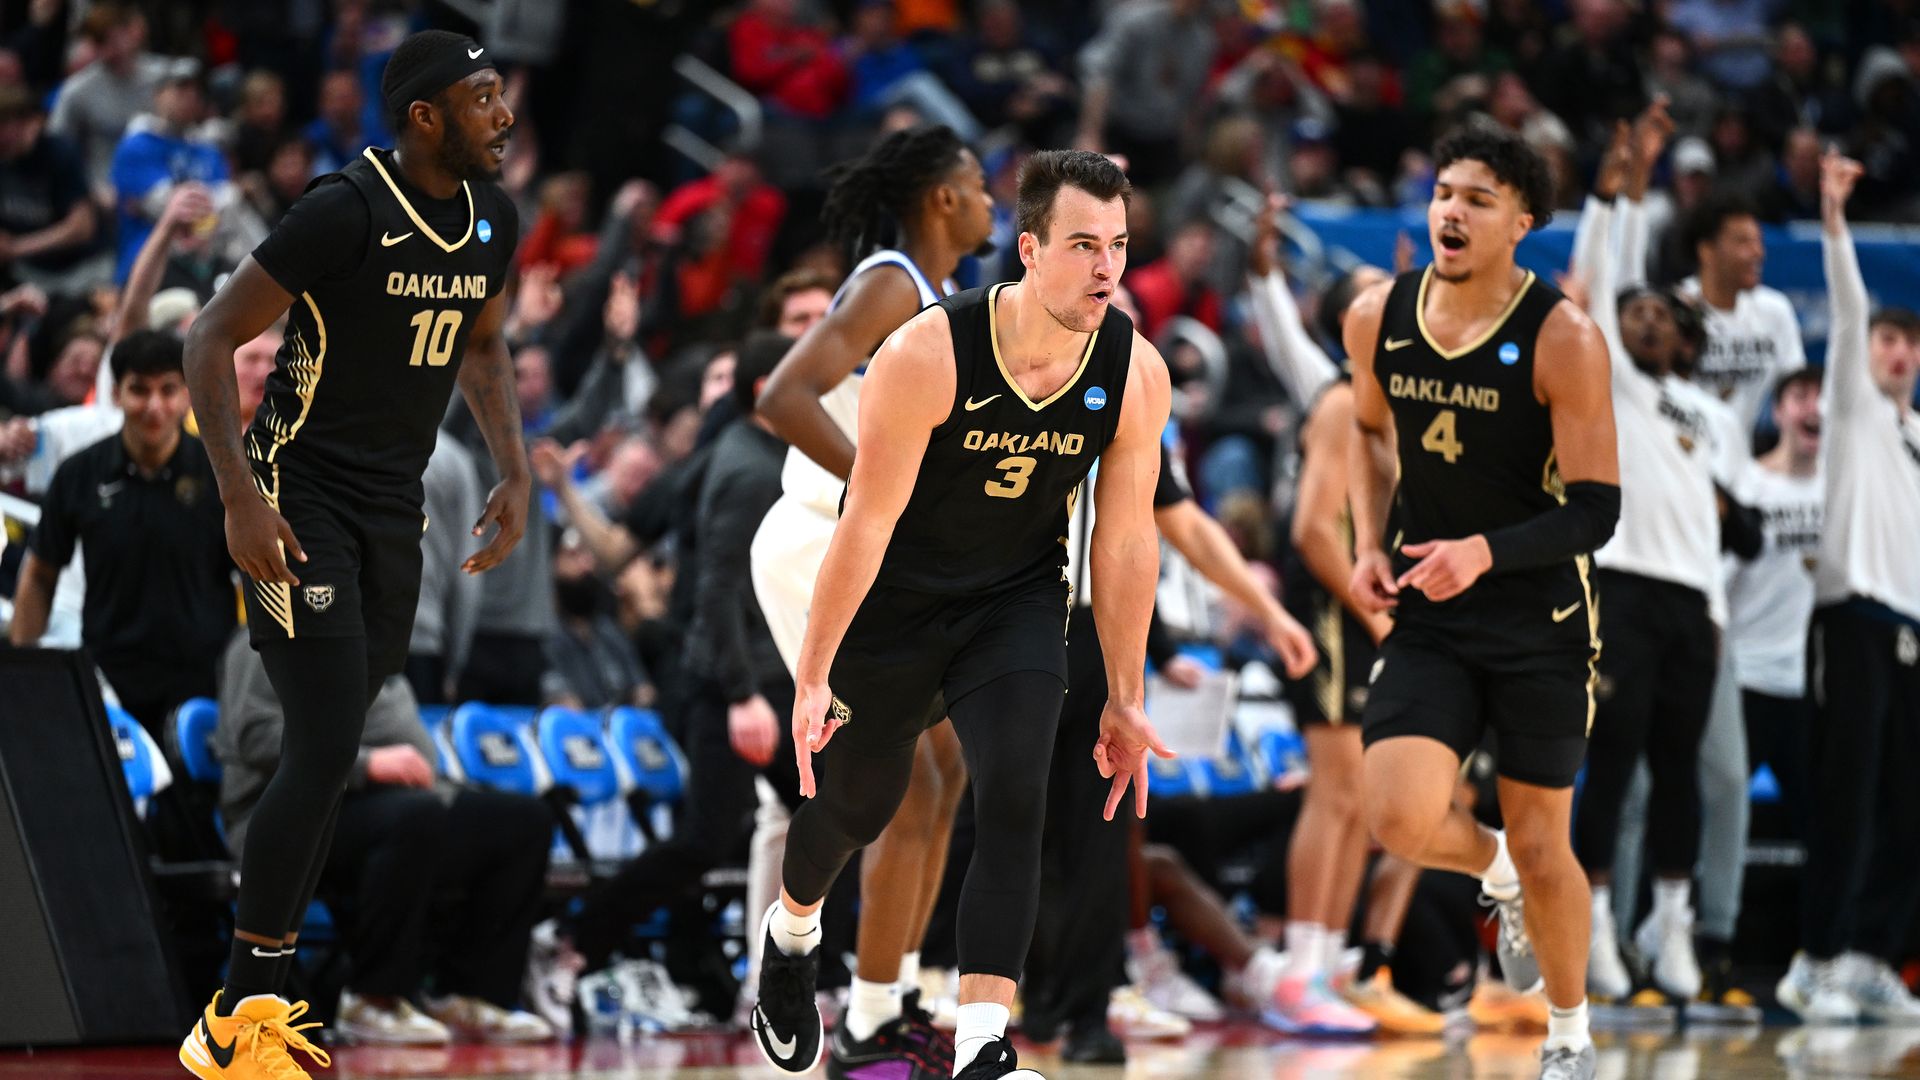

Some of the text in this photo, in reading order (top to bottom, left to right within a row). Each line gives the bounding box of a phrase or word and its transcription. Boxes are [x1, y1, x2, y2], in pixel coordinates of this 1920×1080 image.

[386, 272, 487, 299] OAKLAND
[409, 309, 463, 366] 10
[1086, 396, 1105, 405] NCAA
[1389, 373, 1500, 412] OAKLAND
[963, 430, 1085, 455] OAKLAND
[1421, 409, 1463, 463] 4
[984, 456, 1037, 499] 3
